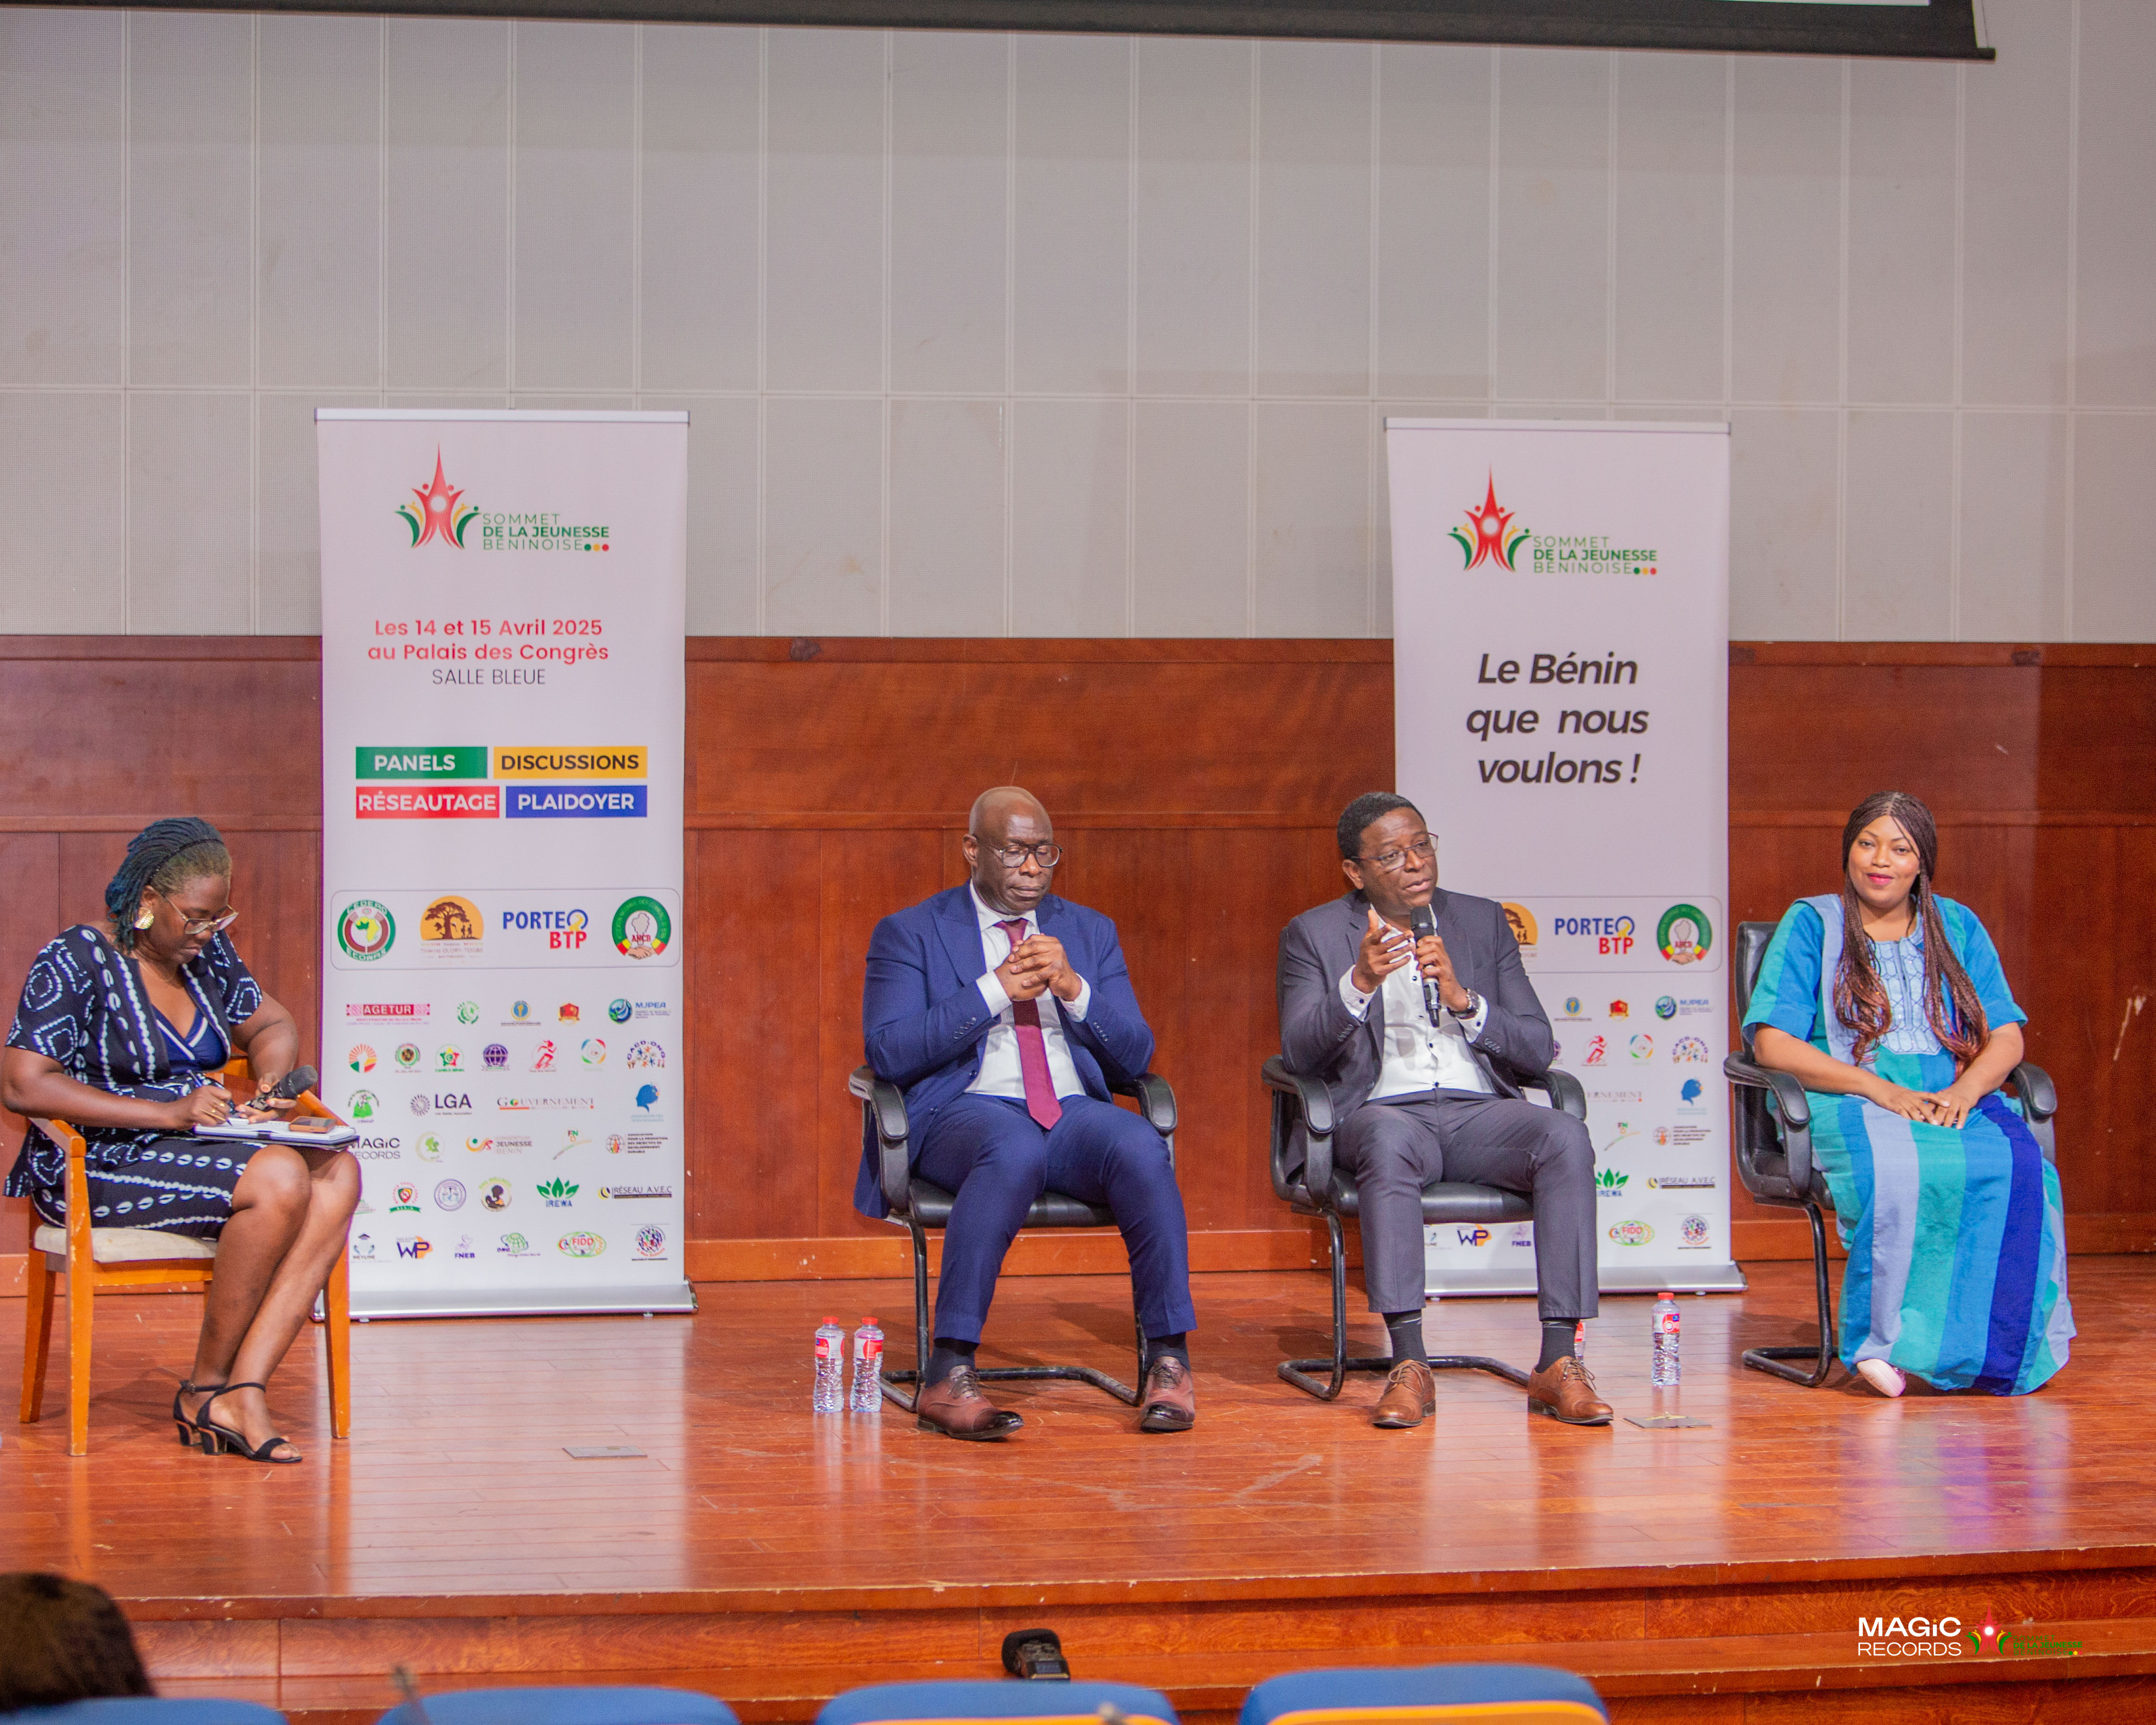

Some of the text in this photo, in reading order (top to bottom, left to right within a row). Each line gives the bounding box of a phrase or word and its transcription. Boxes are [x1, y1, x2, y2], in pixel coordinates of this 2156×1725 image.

[483, 514, 560, 525] SOMMET
[483, 526, 610, 538] DE LA JEUNESSE
[483, 535, 583, 551] BÉNINOISE
[1533, 536, 1609, 548] SOMMET
[1534, 549, 1658, 561] DE LA JEUNESSE
[1534, 558, 1633, 574] BÉNINOISE
[375, 619, 603, 636] Les 14 et 15 Avril 2025
[368, 644, 609, 665] au Palais des Congrès
[1478, 651, 1638, 684] Le Bénin
[432, 669, 546, 685] SALLE BLEUE
[1466, 708, 1650, 741] que nous
[374, 754, 456, 771] PANELS
[502, 754, 639, 770] DISCUSSIONS
[1478, 751, 1641, 784] voulons !
[358, 790, 496, 811] RÉSEAUTAGE
[518, 793, 635, 810] PLAIDOYER
[549, 931, 587, 950] BTP
[1599, 937, 1634, 955] BTP
[363, 1004, 412, 1015] AGETUR
[435, 1093, 472, 1108] LGA
[355, 1150, 401, 1160] ECORDS
[614, 1186, 643, 1194] RÉSEAU
[572, 1237, 594, 1246] FIDD
[1457, 1229, 1489, 1246] WP
[396, 1241, 430, 1259] WP
